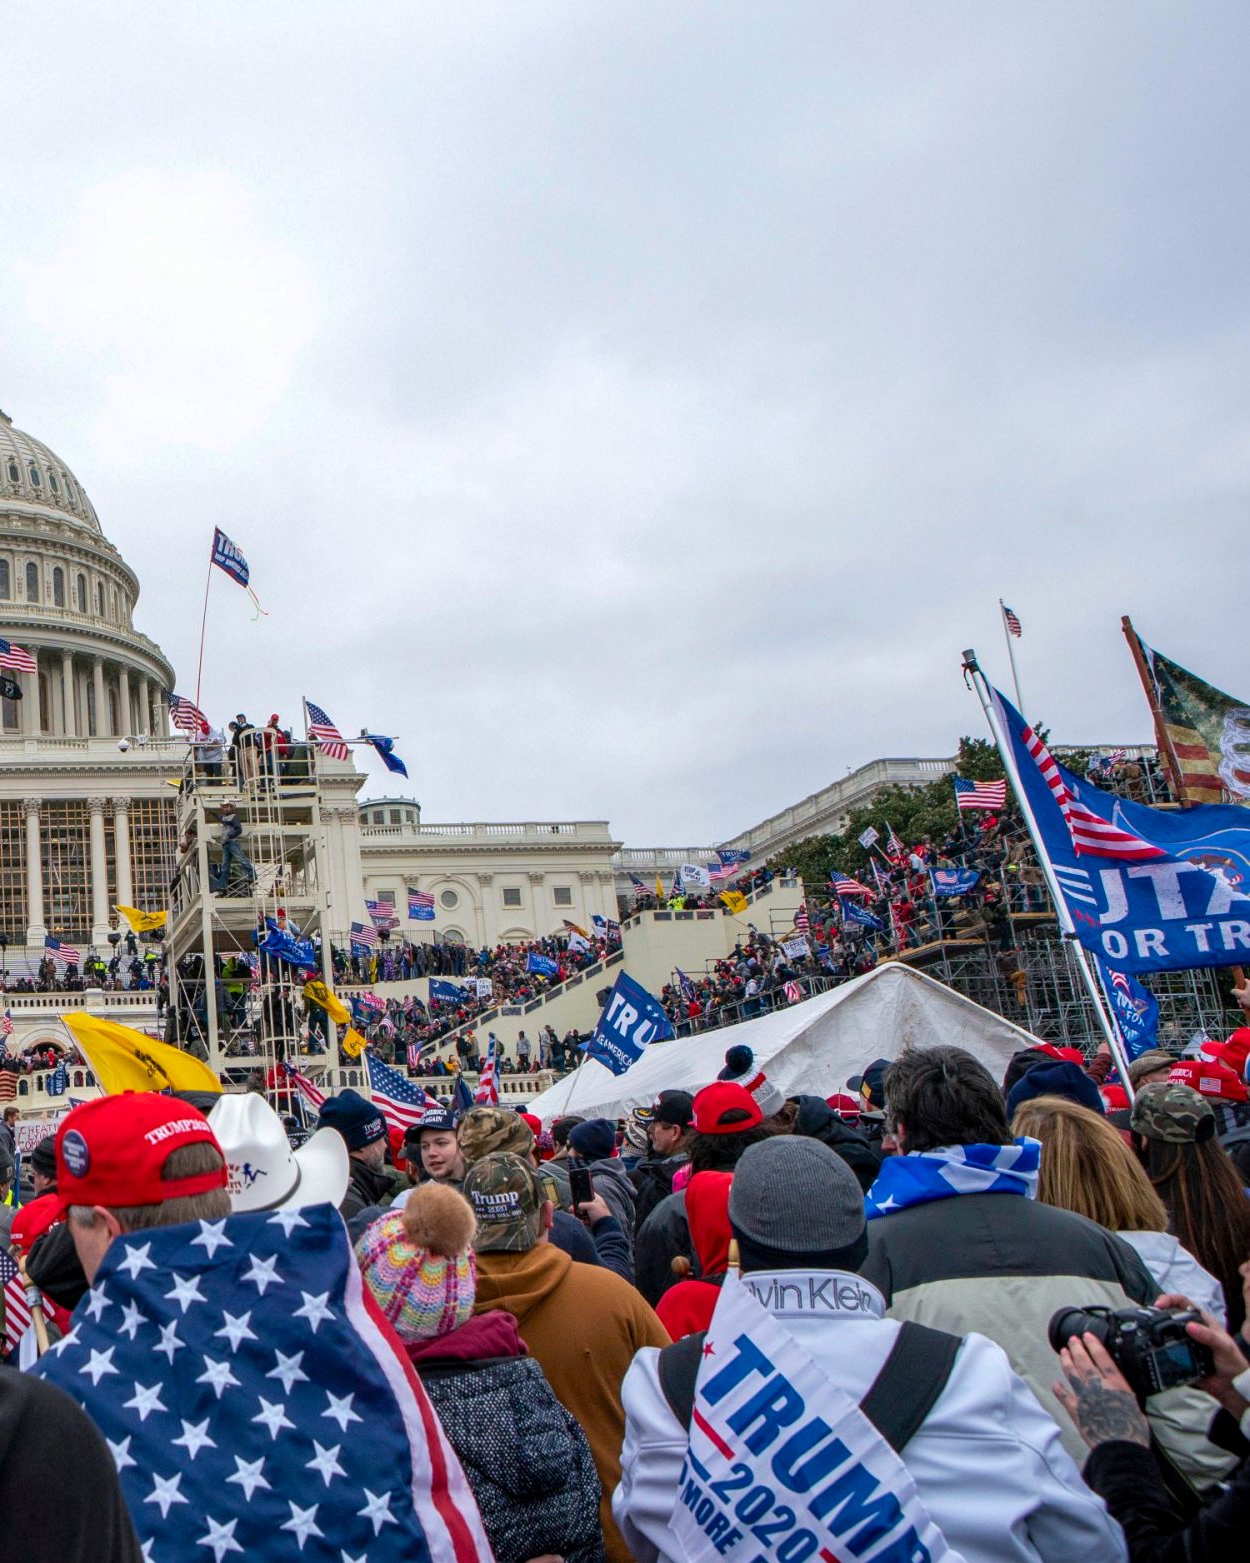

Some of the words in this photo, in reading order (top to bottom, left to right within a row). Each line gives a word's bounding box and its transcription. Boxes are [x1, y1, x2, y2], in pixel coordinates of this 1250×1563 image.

[1102, 928, 1170, 960] OR
[606, 992, 658, 1051] TRU
[472, 1191, 518, 1206] Trump
[808, 1277, 871, 1312] Klein
[679, 1478, 744, 1556] MORE
[709, 1462, 819, 1563] 2020
